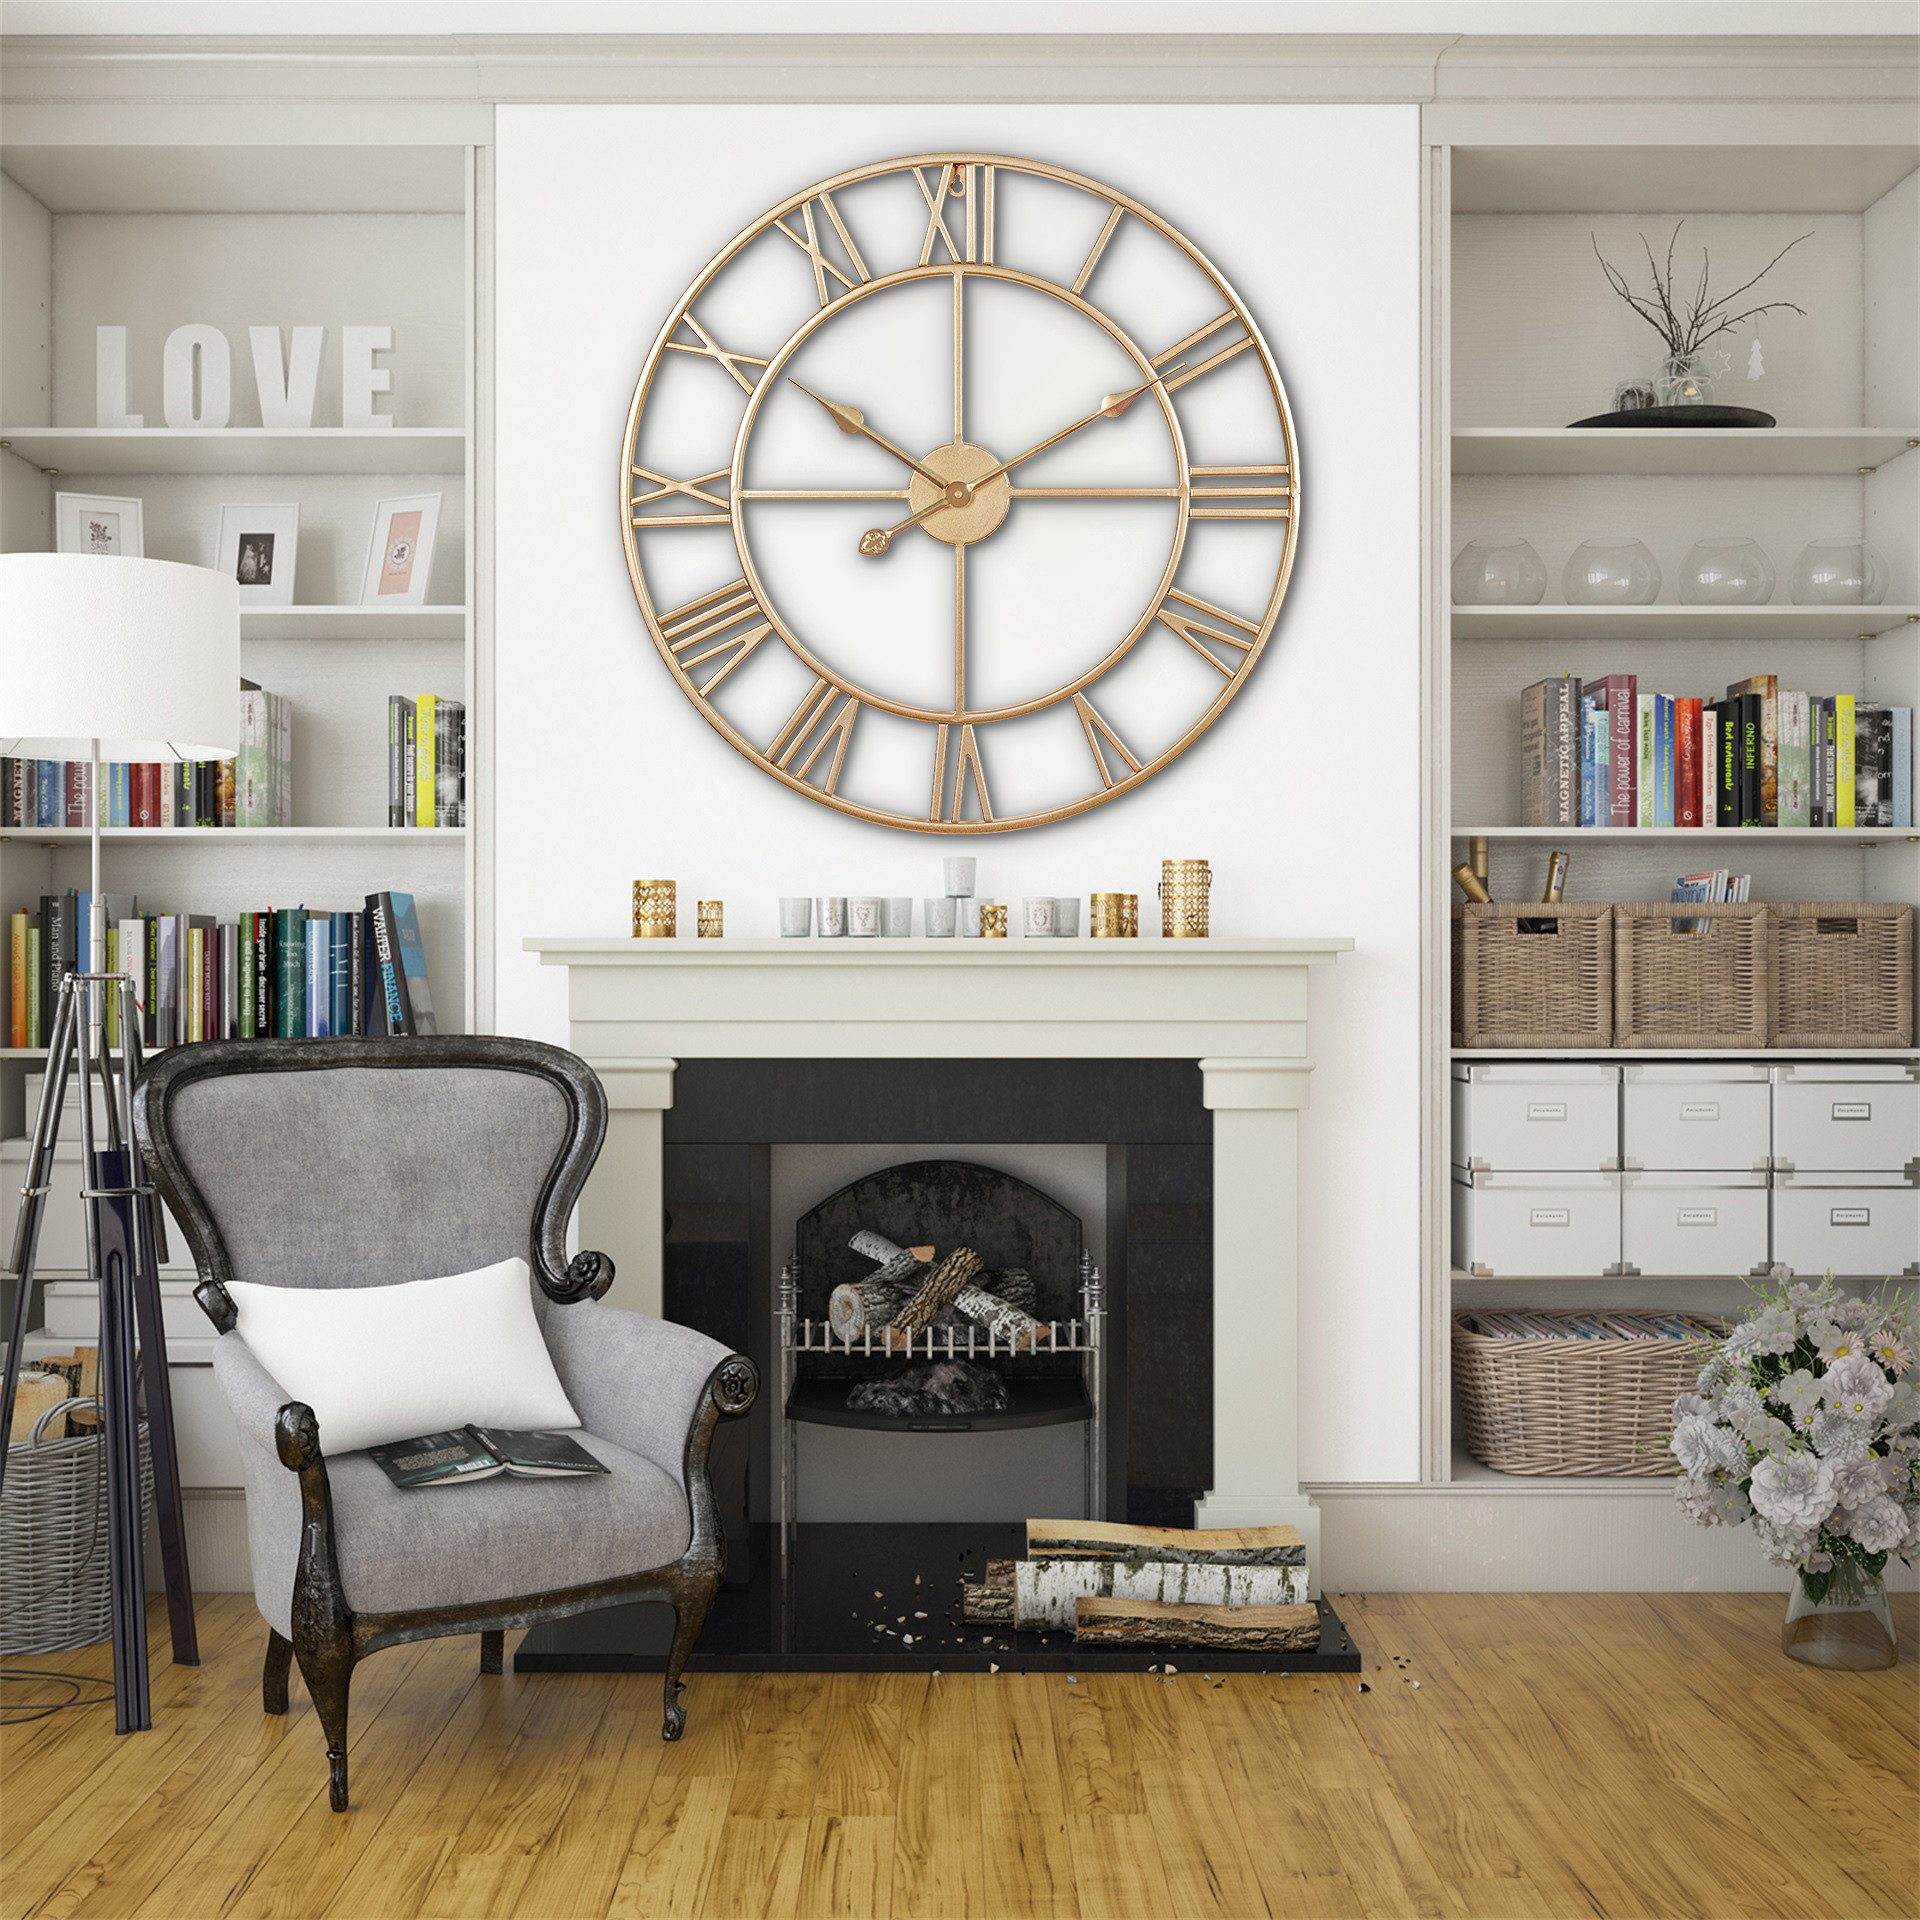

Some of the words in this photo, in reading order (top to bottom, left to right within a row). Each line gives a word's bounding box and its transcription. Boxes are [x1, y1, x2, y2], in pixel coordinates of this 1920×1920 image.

[912, 163, 996, 268] XII
[96, 323, 395, 428] LOVE
[1559, 683, 1571, 743] APPEAL
[1610, 688, 1631, 733] carnival
[1610, 736, 1630, 750] of
[1725, 721, 1734, 740] Best
[1746, 722, 1755, 770] INFERNO
[1617, 754, 1637, 790] power
[1724, 742, 1733, 791] restaurants
[1559, 744, 1570, 822] MAGNETIC
[67, 792, 87, 815] The
[1610, 793, 1630, 816] The
[51, 917, 62, 939] Man
[258, 918, 267, 938] Inside
[372, 906, 392, 962] WALTER
[12, 933, 21, 961] Snow
[51, 942, 62, 960] and
[244, 940, 253, 955] gun
[256, 938, 266, 954] your
[243, 962, 251, 989] handle
[258, 954, 267, 971] brain
[51, 963, 62, 991] Piano
[258, 976, 267, 1003] discover
[243, 989, 251, 997] to
[381, 962, 403, 1023] FINANCE
[243, 998, 251, 1015] How
[258, 1004, 267, 1028] secrets
